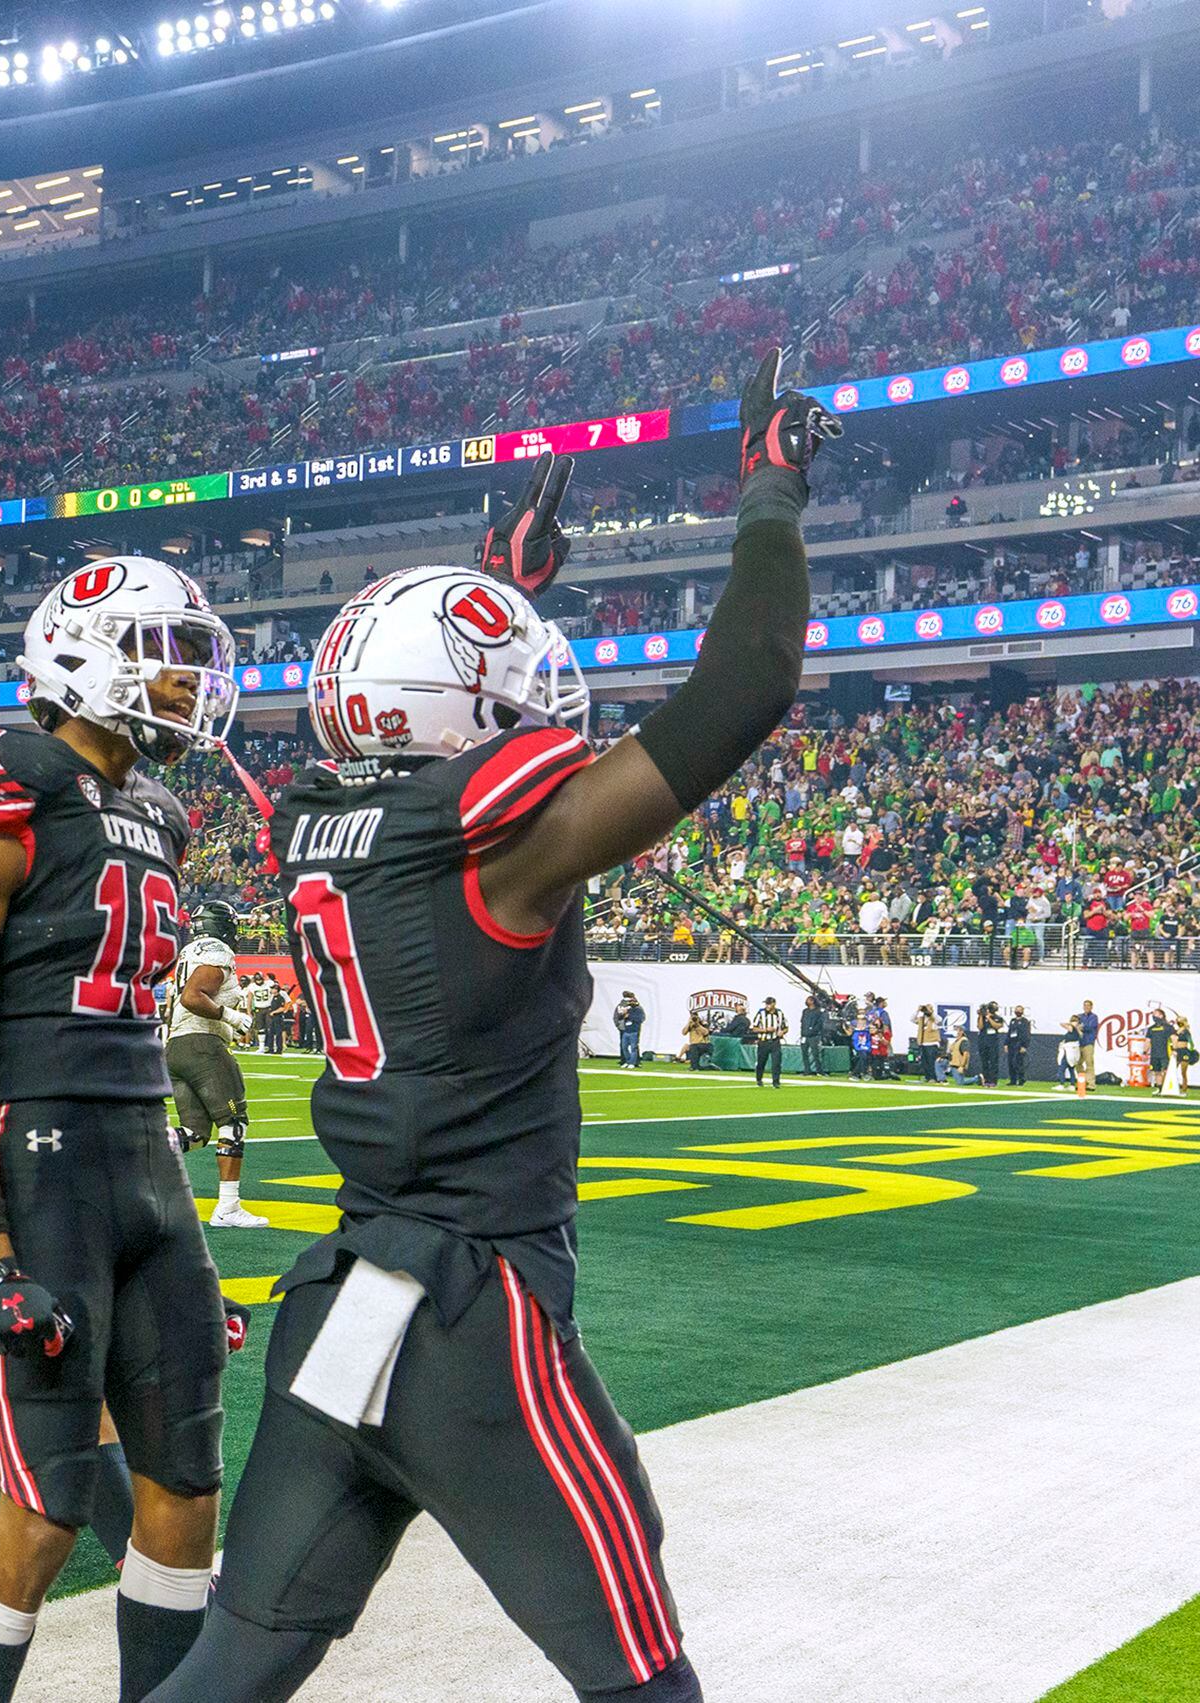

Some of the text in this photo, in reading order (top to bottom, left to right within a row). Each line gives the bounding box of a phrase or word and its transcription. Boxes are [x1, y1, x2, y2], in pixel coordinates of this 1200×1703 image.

[521, 433, 546, 445] TOL
[588, 425, 602, 446] 7
[410, 446, 451, 466] 4:16
[465, 439, 493, 461] 40
[311, 460, 358, 480] Ball 30
[368, 455, 394, 473] 1st
[170, 483, 190, 493] TOL
[240, 469, 297, 490] 3rd & 5
[314, 475, 330, 487] On
[97, 490, 118, 511] O
[129, 488, 141, 506] 0
[73, 566, 116, 603] U
[451, 587, 512, 638] U
[1105, 601, 1125, 618] 76
[1171, 595, 1192, 612] 76
[979, 611, 998, 629] 76
[1040, 606, 1060, 624] 76
[806, 628, 823, 641] 76
[862, 622, 880, 638] 76
[920, 617, 938, 634] 76
[599, 645, 614, 659] 76
[648, 641, 664, 655] 76
[101, 812, 165, 859] UTAH
[286, 808, 384, 863] D. LLOYD
[71, 859, 178, 1019] 16
[669, 953, 689, 961] C137
[910, 955, 932, 967] 138
[288, 872, 386, 1082] 0
[688, 996, 706, 1011] OLD
